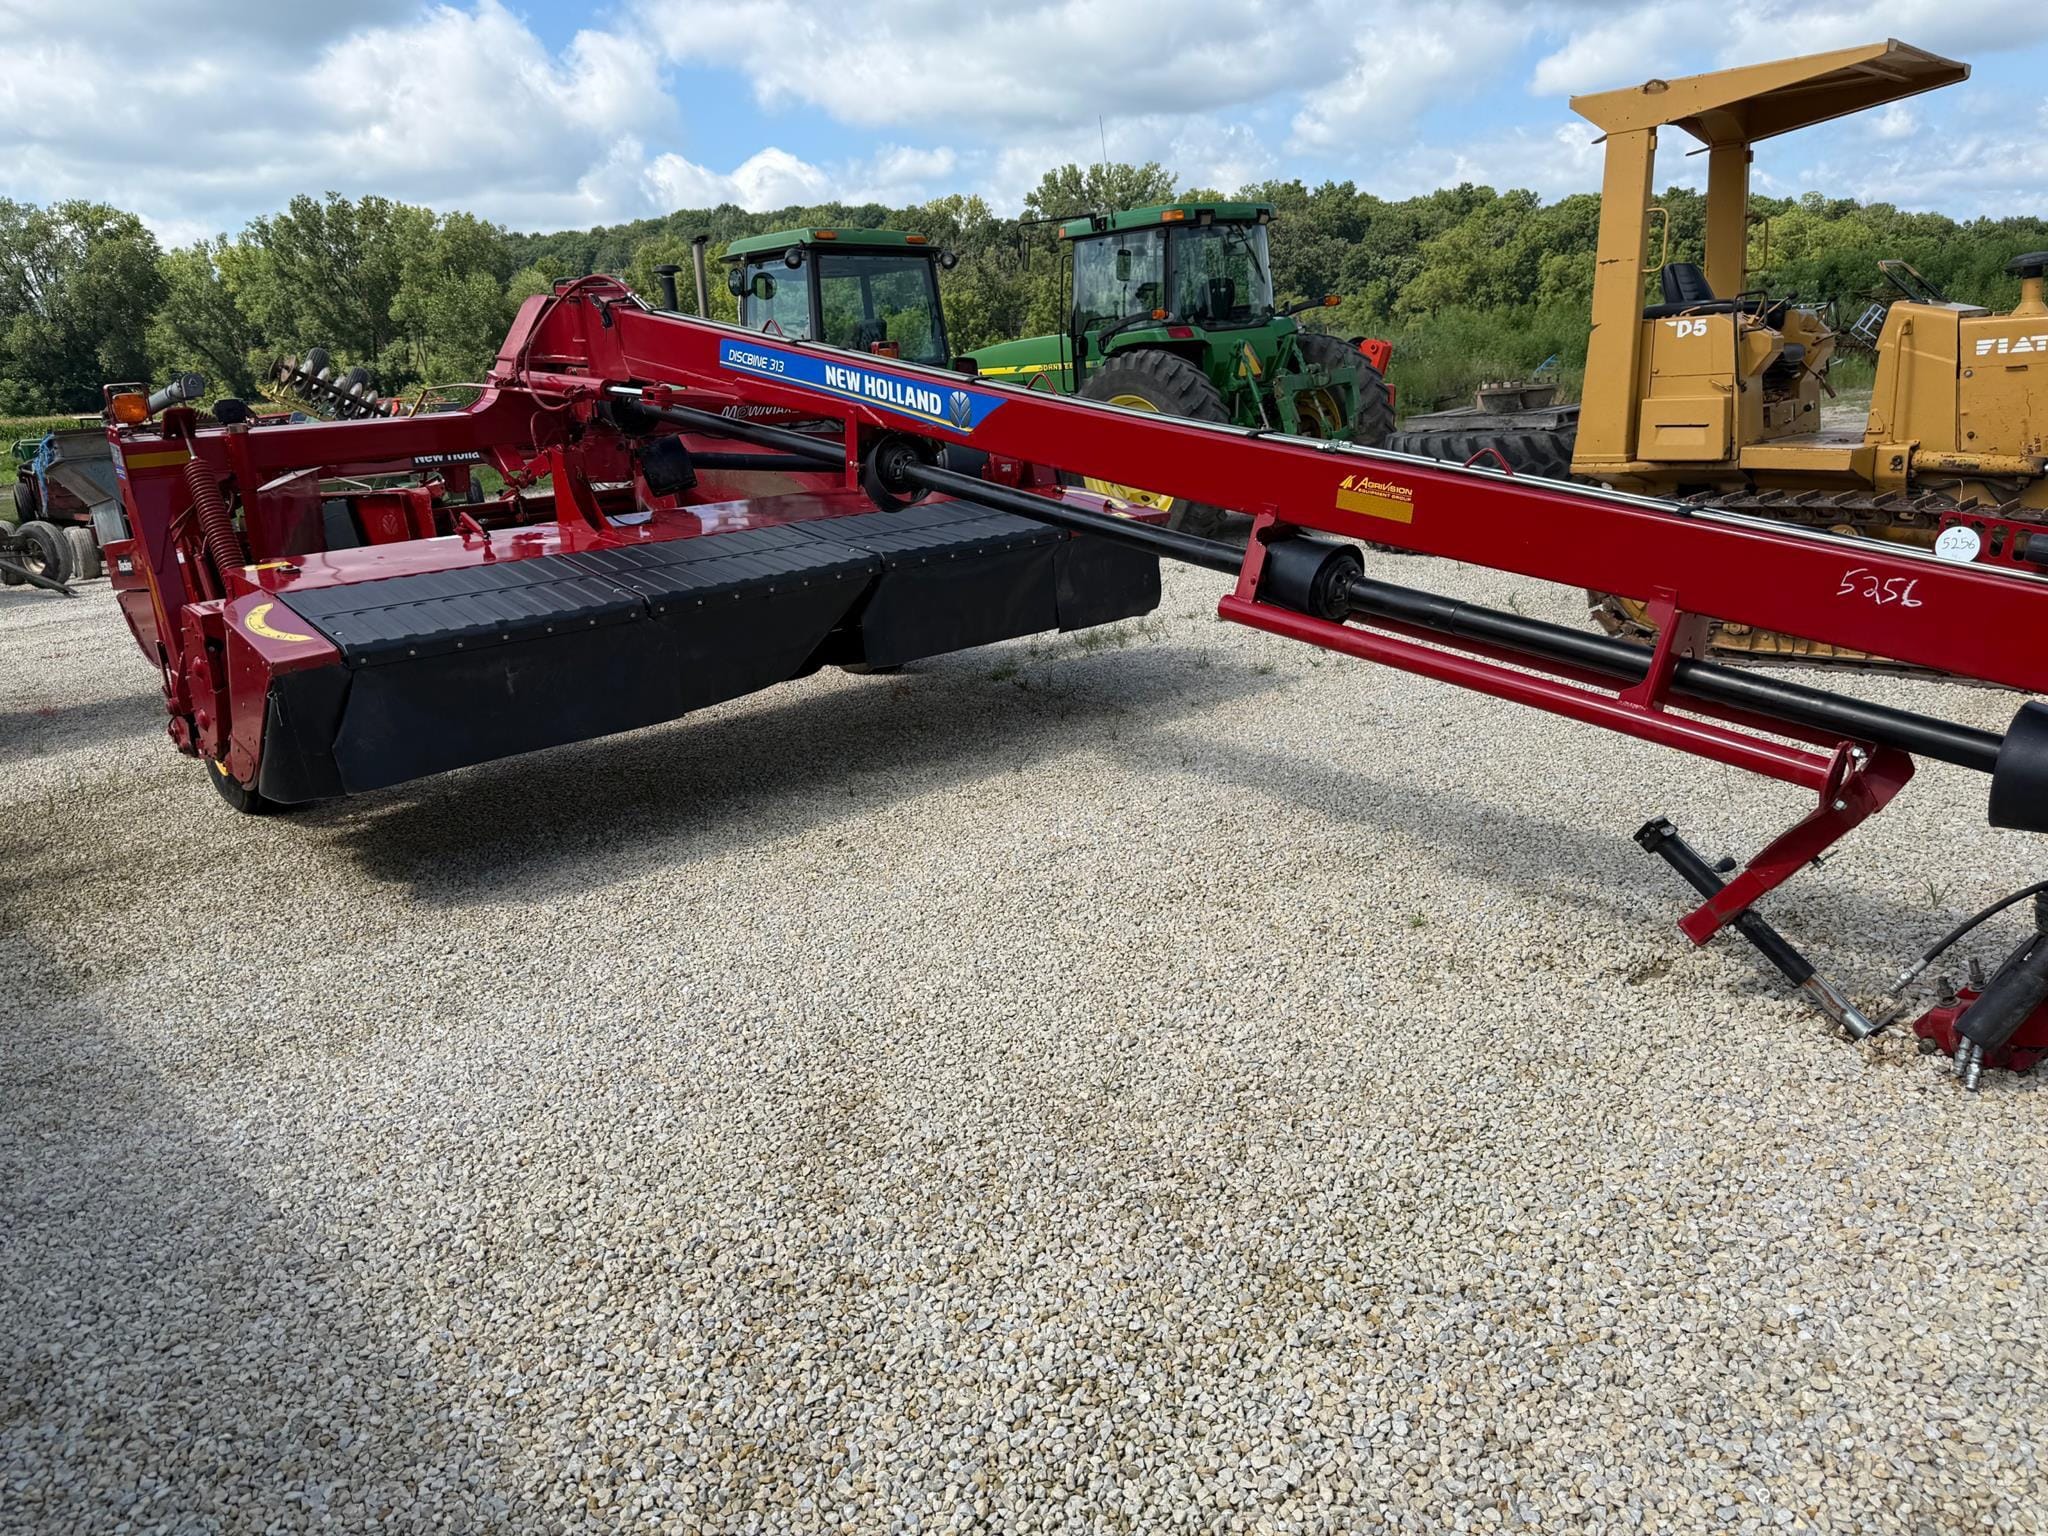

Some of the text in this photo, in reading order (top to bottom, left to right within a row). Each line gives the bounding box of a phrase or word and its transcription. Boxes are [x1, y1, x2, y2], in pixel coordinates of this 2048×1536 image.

[1676, 319, 1707, 337] D5
[1976, 335, 2048, 355] FIAT
[728, 349, 785, 372] DISCBINE 313
[825, 364, 942, 415] NEW HOLLAND
[1942, 537, 1976, 550] 5256
[1836, 568, 1923, 607] 5256
